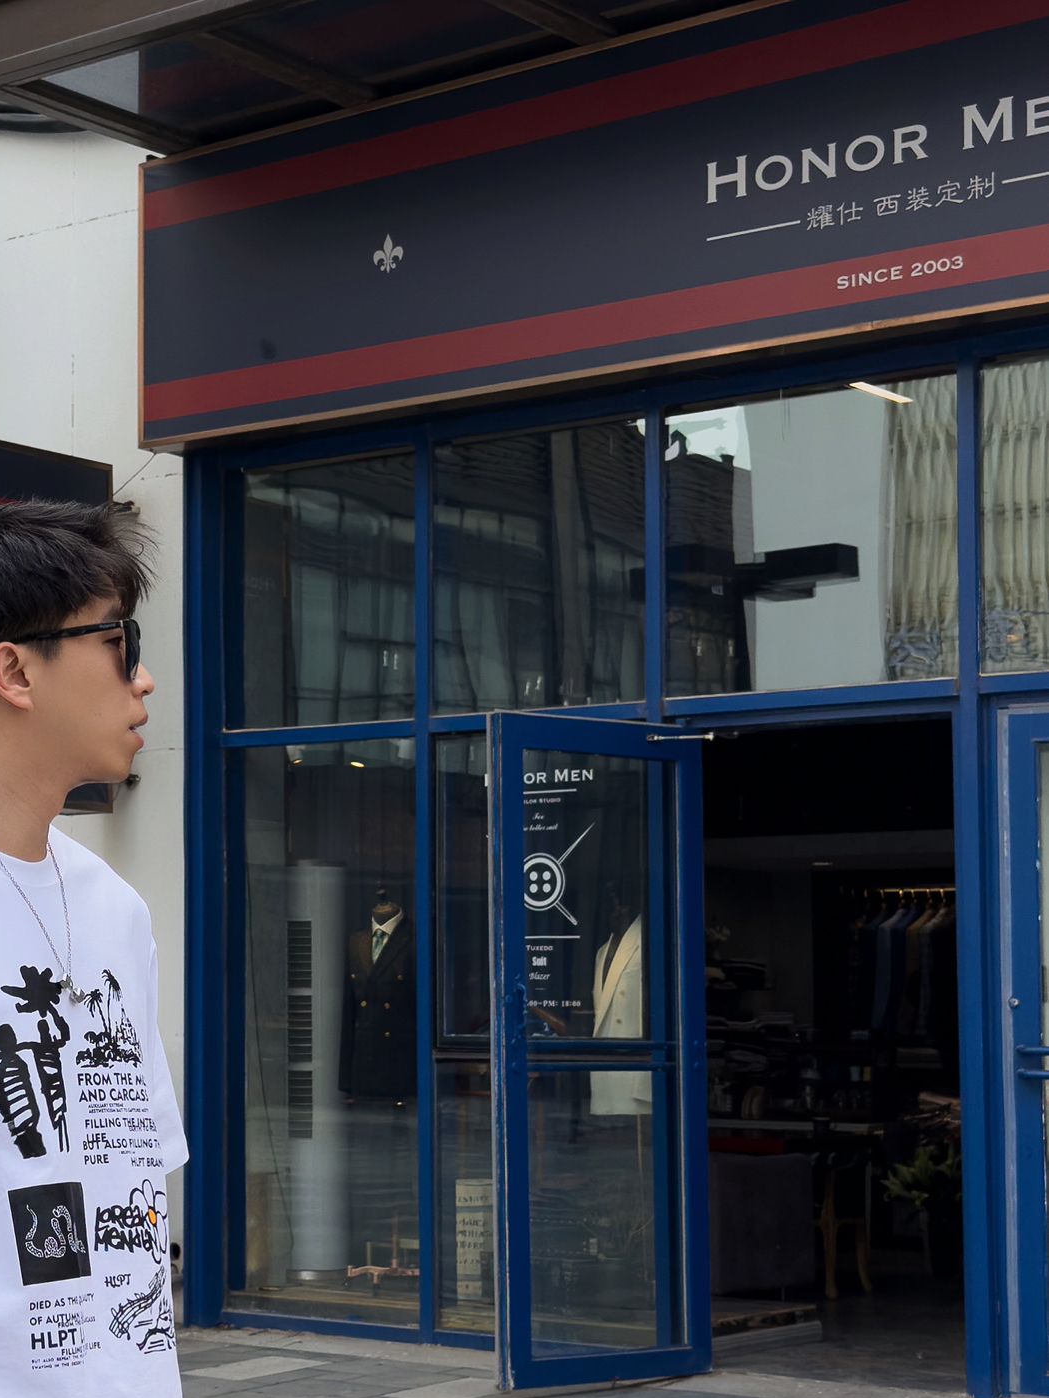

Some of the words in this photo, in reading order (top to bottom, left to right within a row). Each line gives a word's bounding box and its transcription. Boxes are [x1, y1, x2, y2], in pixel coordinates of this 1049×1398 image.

[706, 124, 929, 205] HONOR
[962, 96, 1049, 150] ME
[806, 200, 865, 231] 耀仕
[873, 171, 996, 217] 西装定制
[836, 265, 904, 291] SINCE
[910, 255, 965, 278] 2003
[554, 768, 594, 783] MEN
[526, 944, 554, 952] TUXEDO
[532, 955, 547, 967] Suit
[528, 971, 551, 981] Blazer
[77, 1072, 112, 1086] FROM
[113, 1072, 133, 1086] THE
[78, 1088, 106, 1103] AND
[84, 1117, 122, 1129] FILLING
[86, 1132, 107, 1143] LIFE
[82, 1140, 100, 1151] BUT
[104, 1138, 128, 1149] ALSO
[84, 1153, 109, 1166] PURE
[29, 1299, 52, 1311] DIED
[54, 1297, 66, 1308] AS
[29, 1316, 43, 1326] OF
[30, 1327, 77, 1350] HLPT
